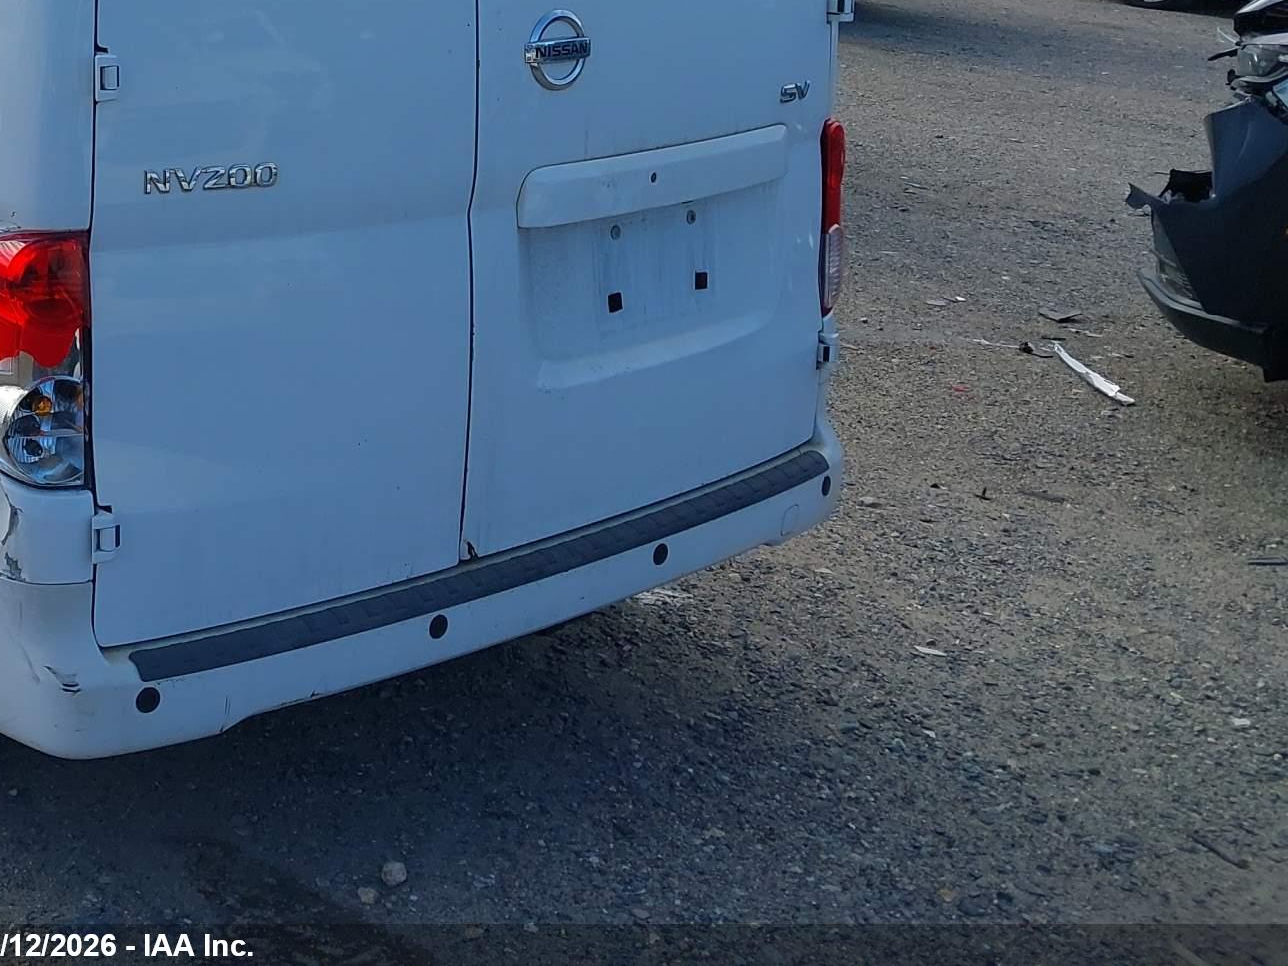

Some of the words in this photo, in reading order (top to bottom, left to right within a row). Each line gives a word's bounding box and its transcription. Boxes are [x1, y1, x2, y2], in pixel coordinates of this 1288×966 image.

[535, 42, 588, 58] NISSAN
[780, 80, 811, 103] SV
[143, 162, 278, 194] NV200
